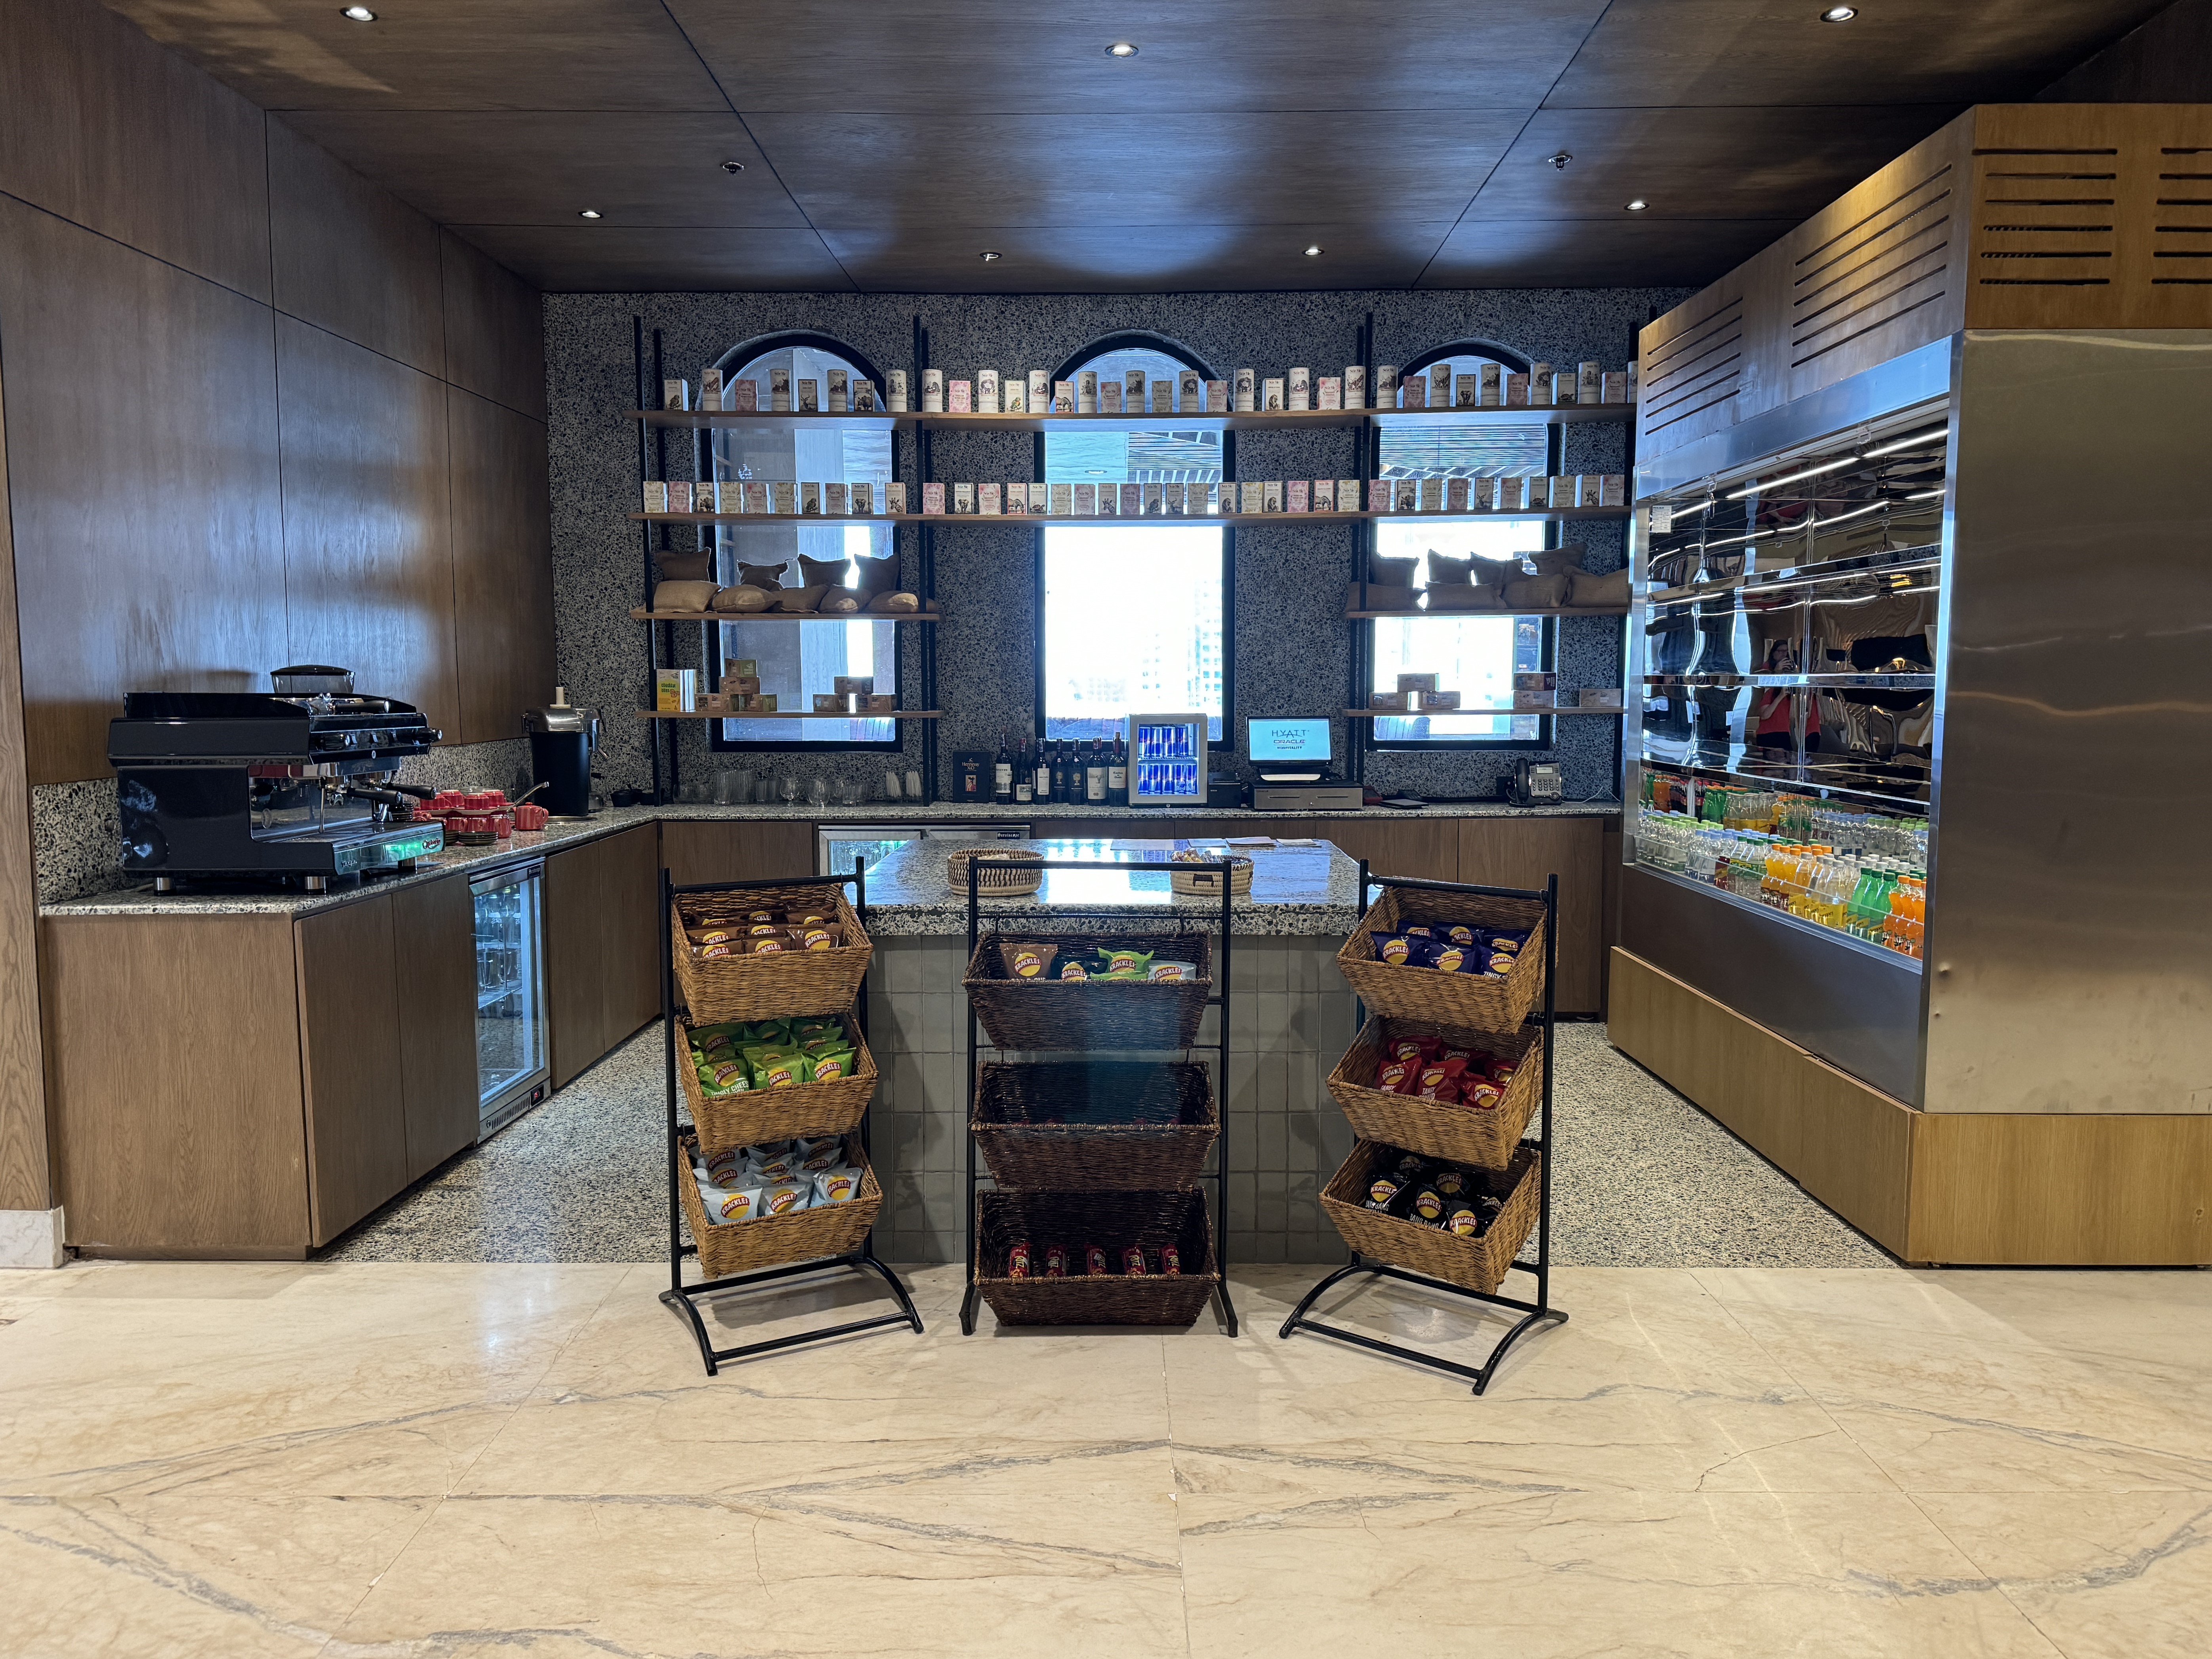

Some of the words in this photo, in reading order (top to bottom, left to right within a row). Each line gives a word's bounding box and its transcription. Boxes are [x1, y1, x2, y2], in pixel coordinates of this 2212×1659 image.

[1272, 730, 1306, 738] HYATT
[805, 934, 830, 948] KRACKLES
[1383, 946, 1409, 957] KRACKLES
[1014, 957, 1041, 972] KRACKLES
[1110, 959, 1136, 972] KRACKLES
[1062, 969, 1086, 979] KRACKLES
[1155, 967, 1183, 979] KRACKLES
[706, 1036, 730, 1052] KRACKLES
[1396, 1045, 1421, 1057] KRACKLES
[1444, 1051, 1470, 1060] KRACKLES
[714, 1064, 738, 1083] KRACKLES
[815, 1062, 841, 1079] KRACKLES
[1382, 1067, 1405, 1081] KRACKLES
[731, 1081, 749, 1092] CHEES
[1422, 1086, 1436, 1095] TANGY
[1474, 1089, 1500, 1102] KRACKLES
[708, 1151, 734, 1169] KRACKLES
[1399, 1161, 1424, 1170] KRACKLES
[1436, 1174, 1463, 1186] KRACKLES
[721, 1197, 749, 1216] KRACKLES
[771, 1193, 797, 1210] KRACKLES
[1416, 1198, 1443, 1213] KRACKLES
[1449, 1217, 1477, 1228] KRACKLES
[1014, 1256, 1025, 1269] RITZ
